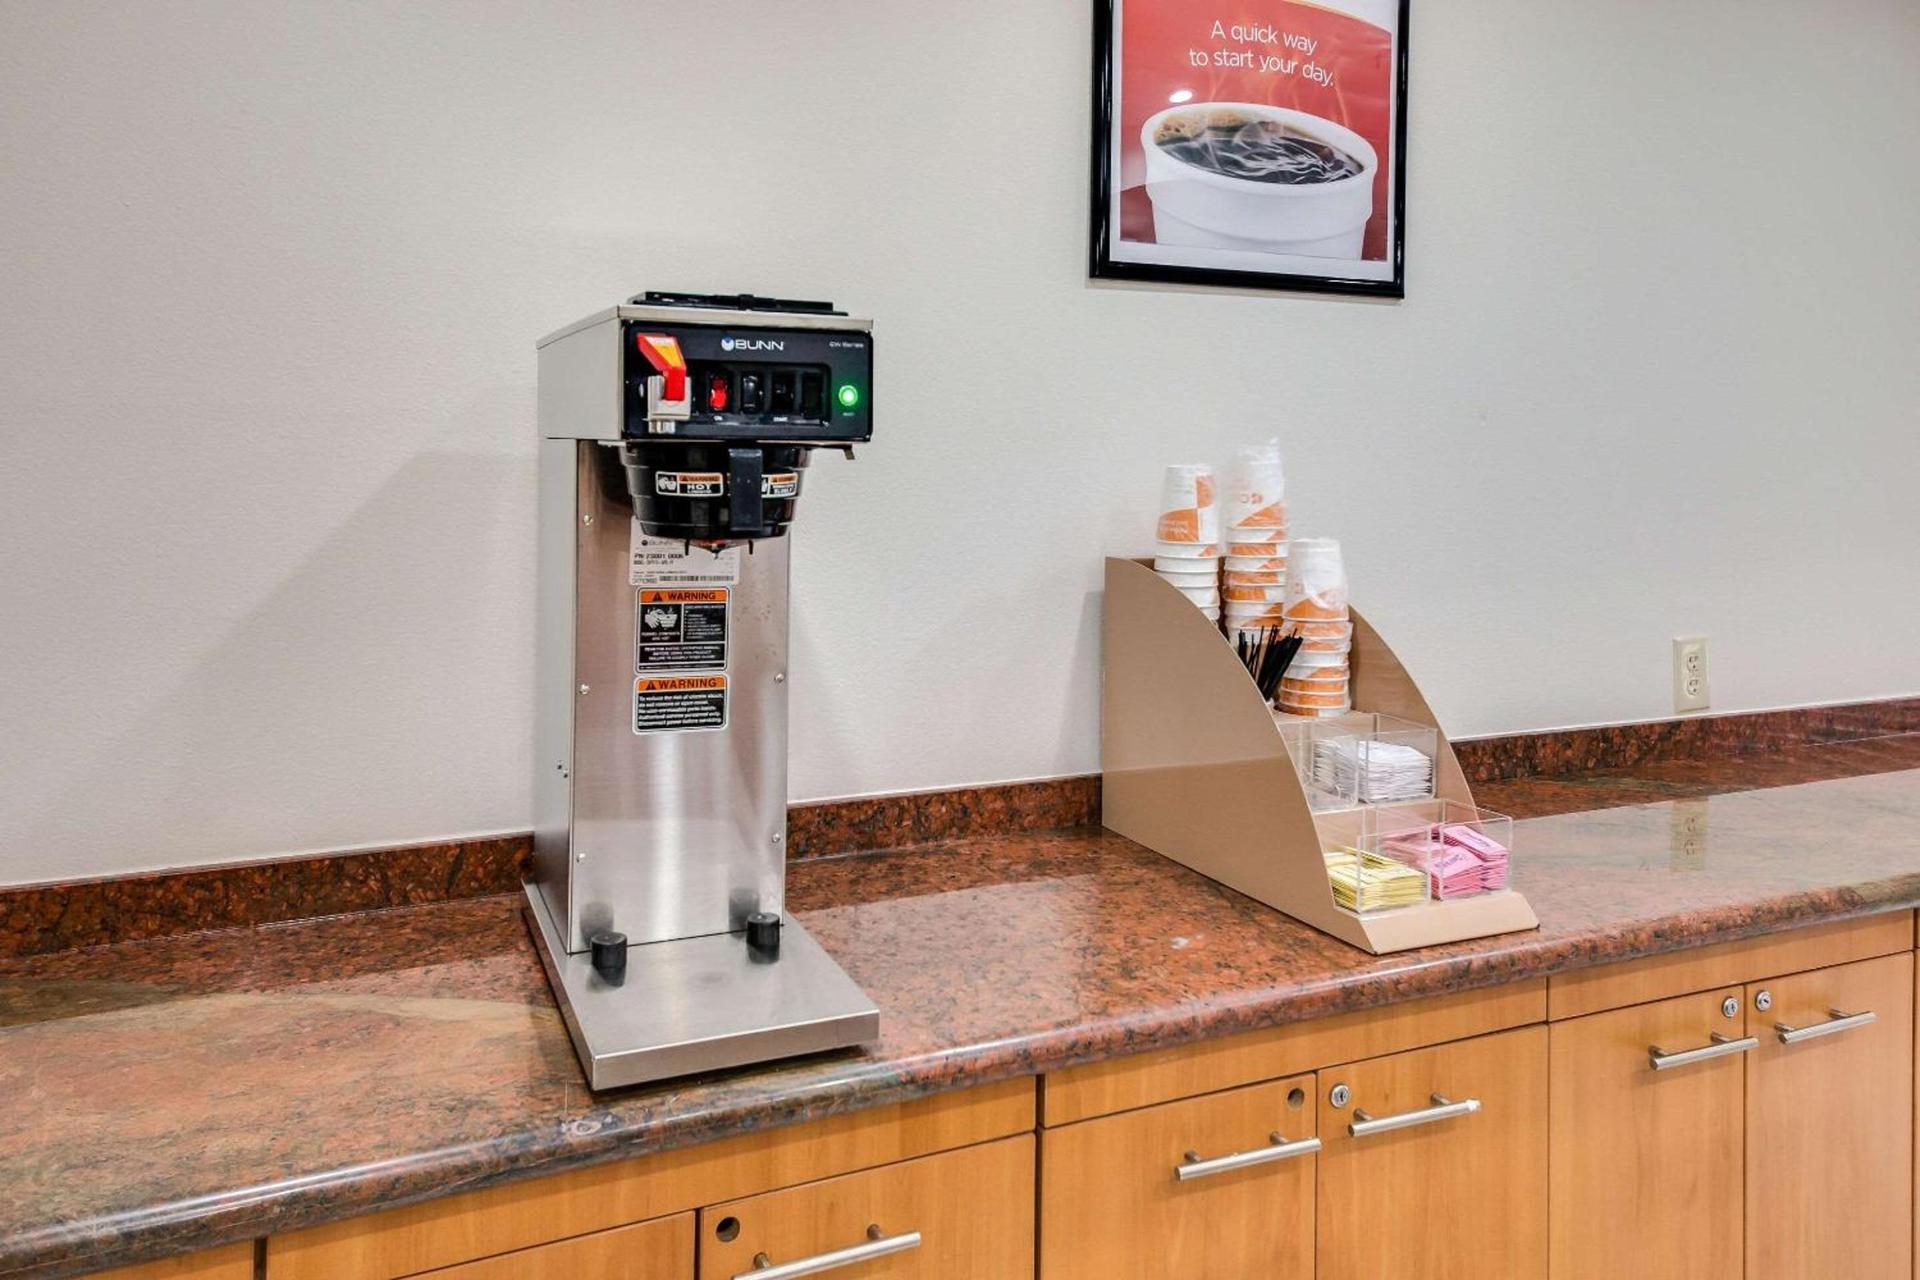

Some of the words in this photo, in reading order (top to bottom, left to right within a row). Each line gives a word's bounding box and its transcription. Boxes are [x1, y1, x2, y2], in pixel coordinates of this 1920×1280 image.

[1210, 20, 1226, 40] A
[1230, 23, 1278, 45] quick
[1283, 32, 1317, 55] way
[1189, 48, 1209, 67] to
[1213, 48, 1254, 68] start
[1259, 53, 1298, 75] your
[1302, 60, 1335, 87] day.
[735, 338, 784, 352] BUNN
[668, 591, 716, 600] WARNING
[658, 678, 717, 689] WARNING
